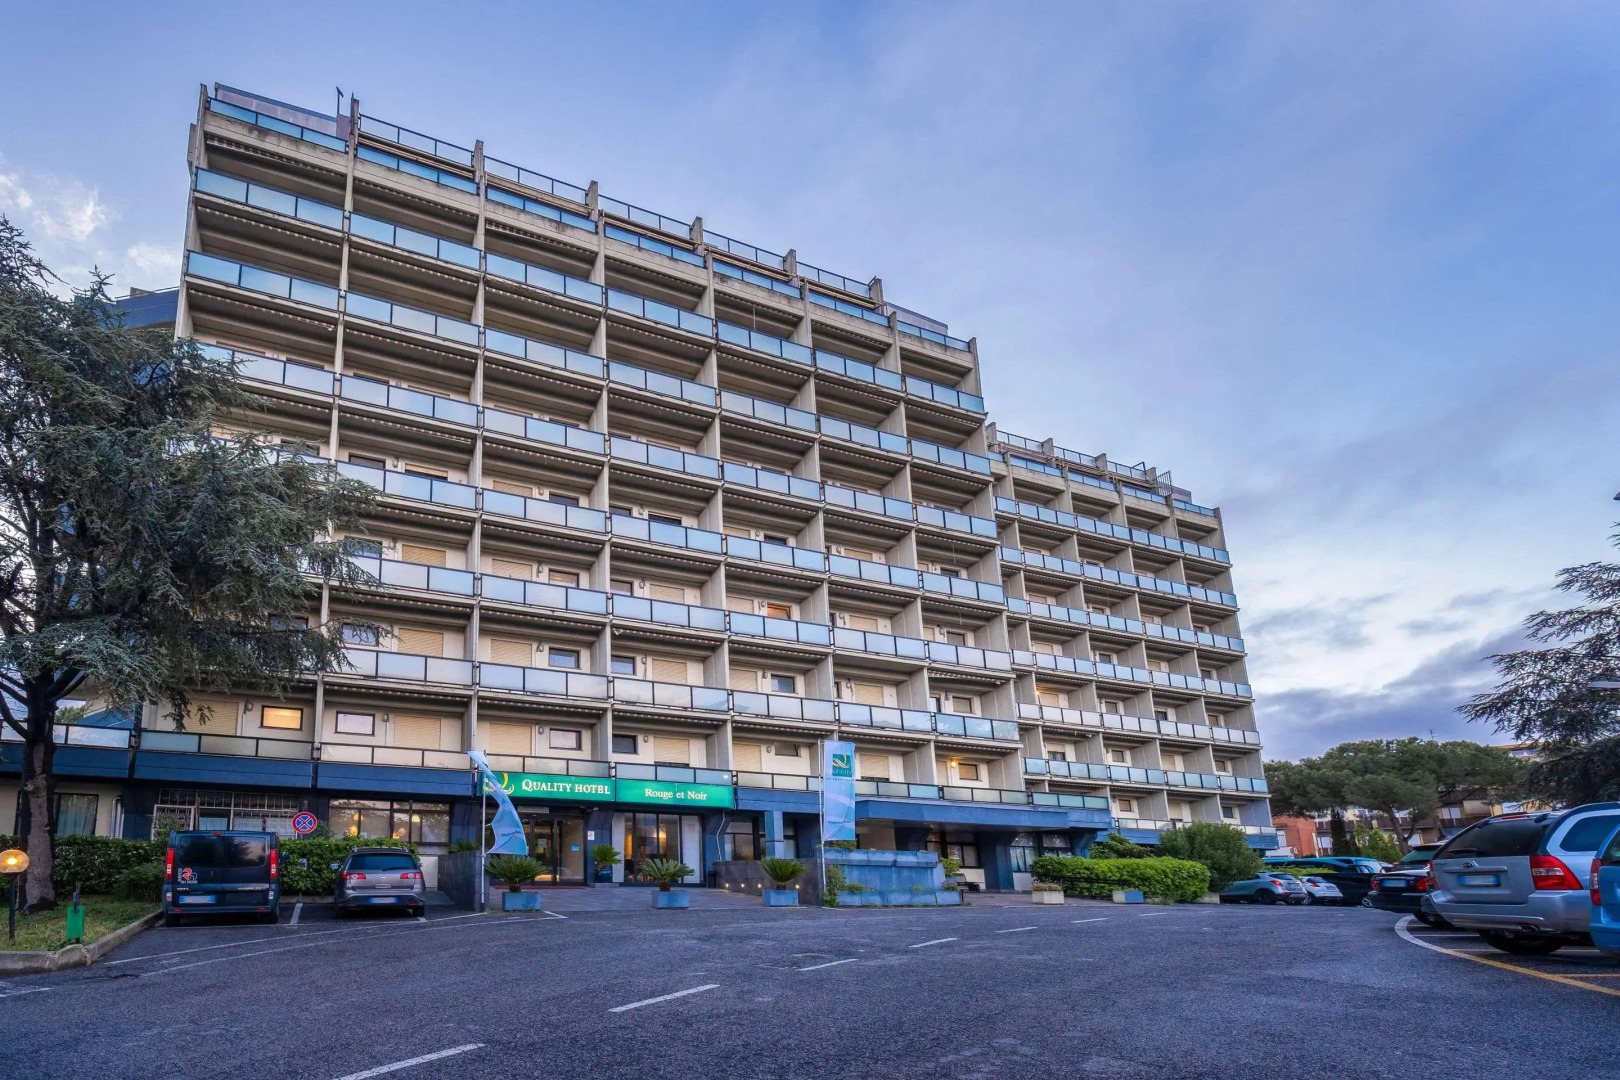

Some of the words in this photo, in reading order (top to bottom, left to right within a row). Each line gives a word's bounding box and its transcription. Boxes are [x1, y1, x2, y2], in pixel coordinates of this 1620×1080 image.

[521, 778, 572, 792] QUALITY
[574, 783, 611, 794] HOTEL
[644, 788, 673, 799] Rouge
[676, 791, 685, 799] et
[687, 791, 708, 800] Noir
